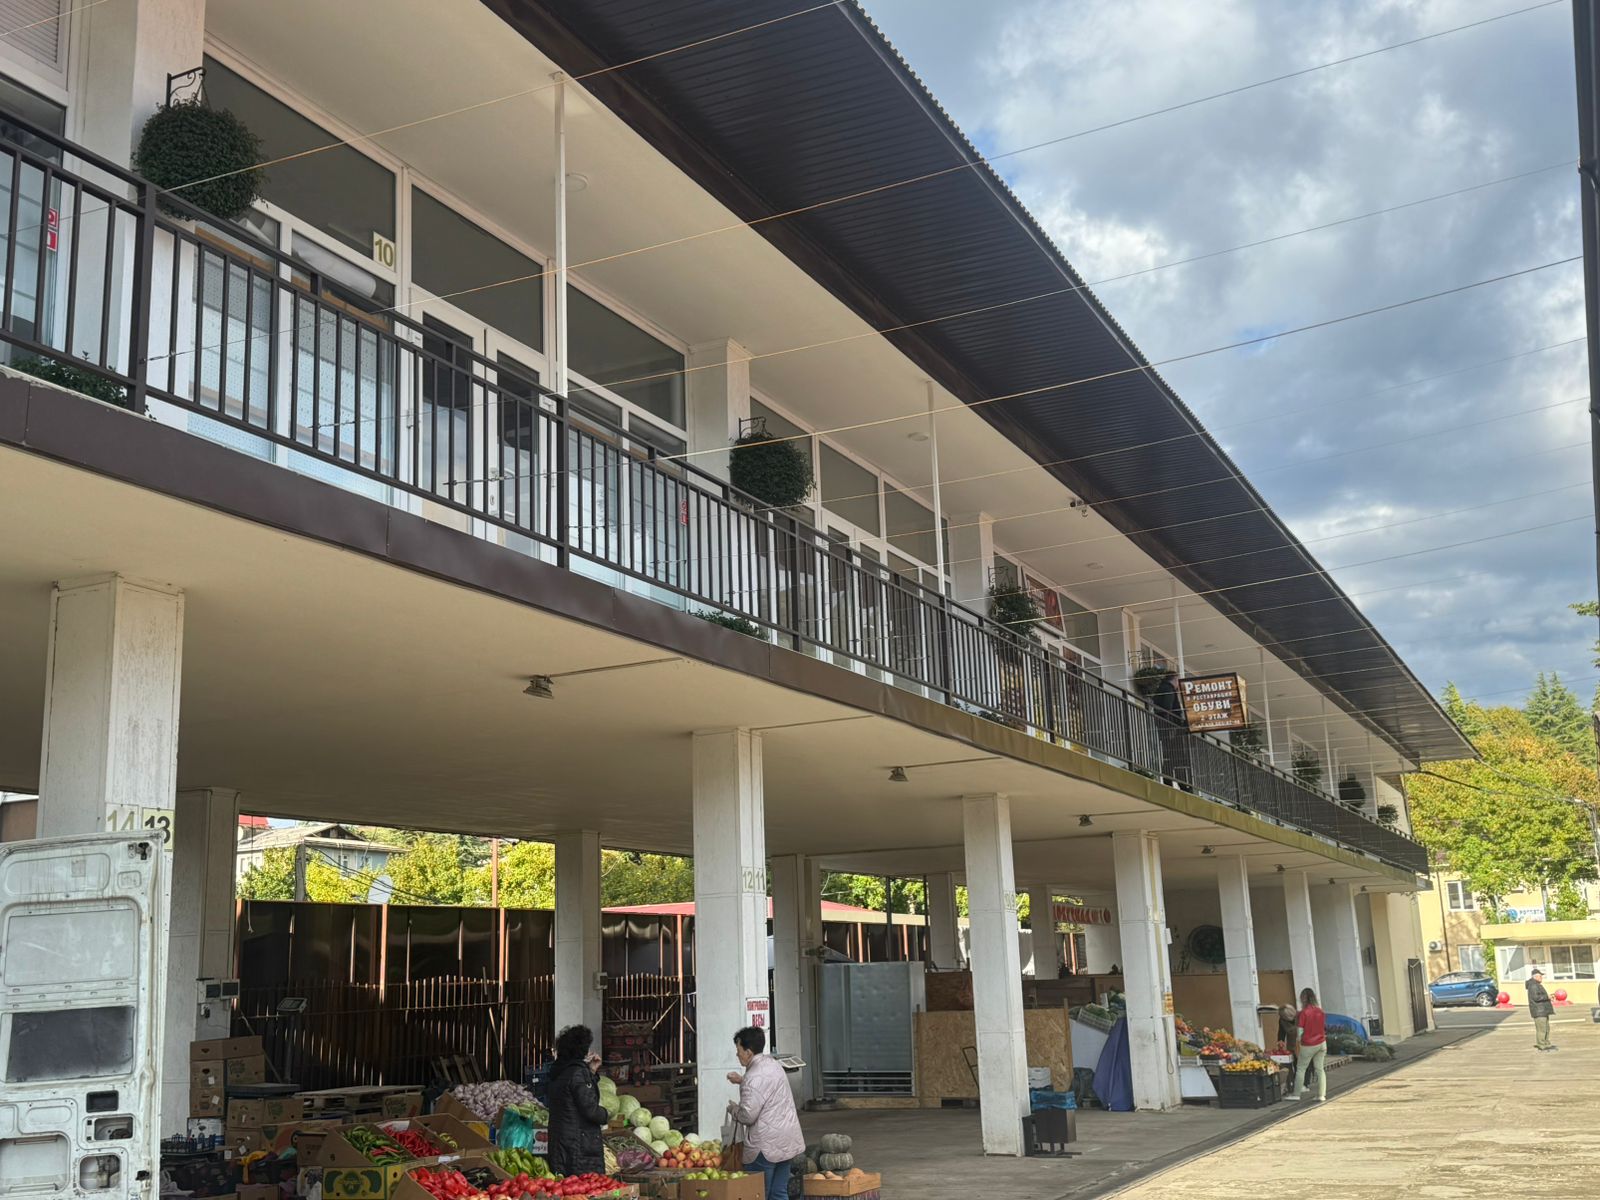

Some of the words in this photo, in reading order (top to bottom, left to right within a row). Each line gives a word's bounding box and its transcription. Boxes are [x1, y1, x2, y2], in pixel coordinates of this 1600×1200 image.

[374, 238, 394, 267] 10
[1193, 700, 1231, 712] ОБУВИ
[1209, 712, 1229, 720] ЭТАЖ
[144, 815, 171, 844] 13
[743, 871, 753, 889] 12
